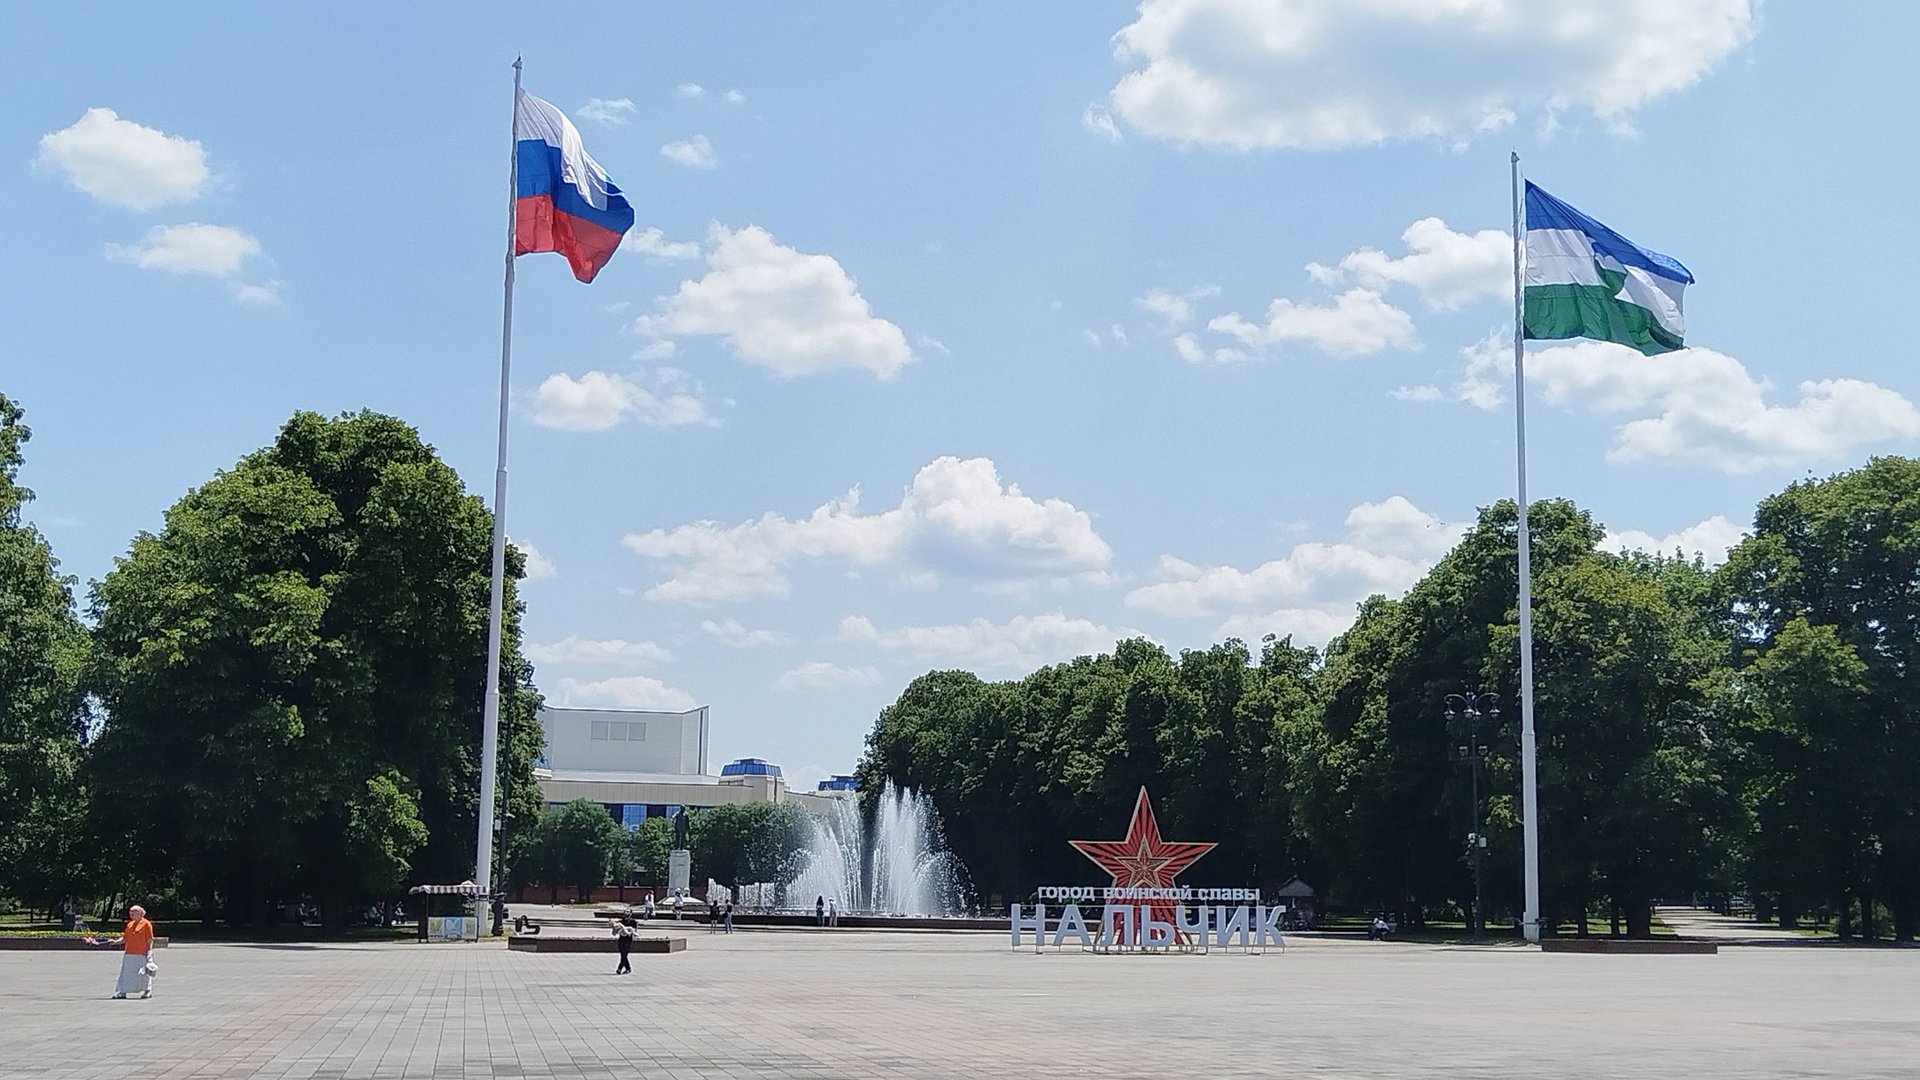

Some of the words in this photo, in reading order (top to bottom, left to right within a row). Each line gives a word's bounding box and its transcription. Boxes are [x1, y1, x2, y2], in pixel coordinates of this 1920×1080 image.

[1037, 886, 1095, 902] город
[1103, 885, 1192, 900] воинской
[1198, 888, 1260, 901] славы
[1011, 904, 1286, 947] НАЛЬЧИК
